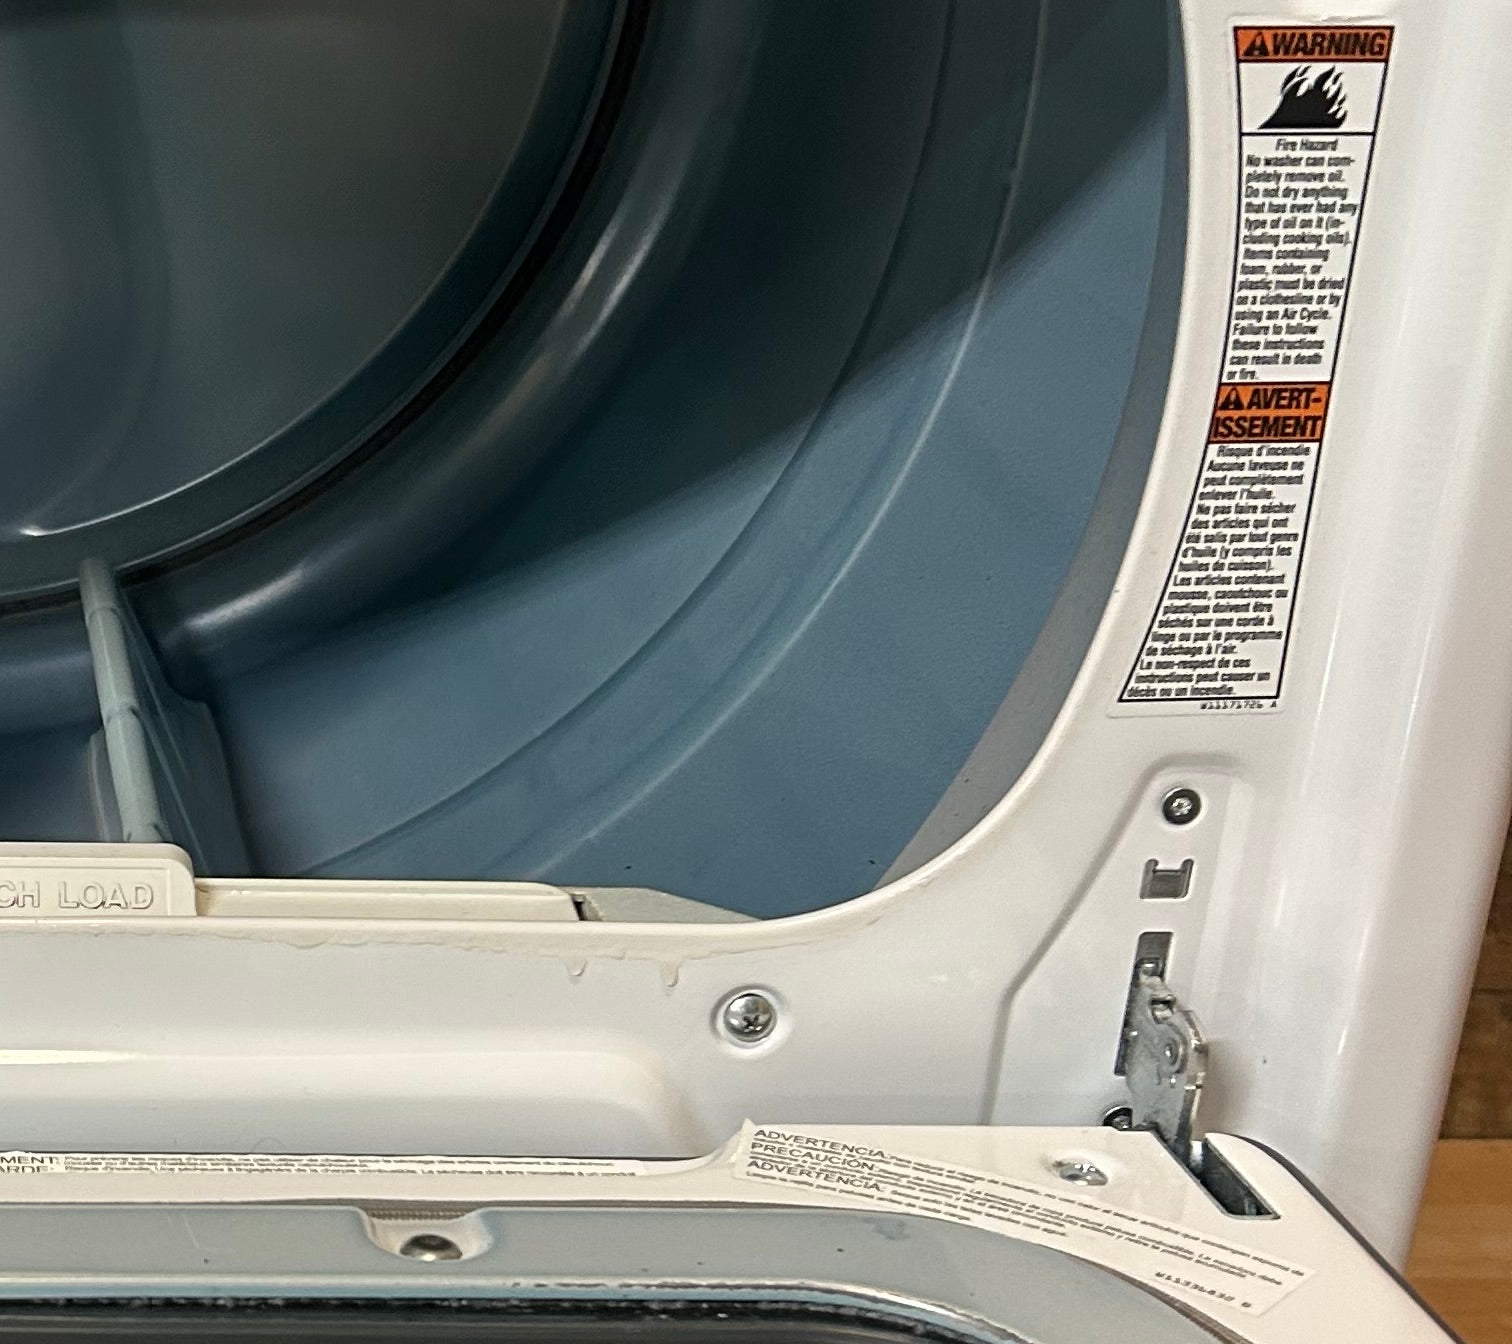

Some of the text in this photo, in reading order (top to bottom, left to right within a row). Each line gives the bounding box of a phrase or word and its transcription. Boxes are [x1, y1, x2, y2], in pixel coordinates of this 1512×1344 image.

[1272, 32, 1386, 57] WARNING
[1246, 387, 1322, 410] AVERT-
[1214, 416, 1320, 438] ISSEMENT
[57, 882, 154, 910] LOAD
